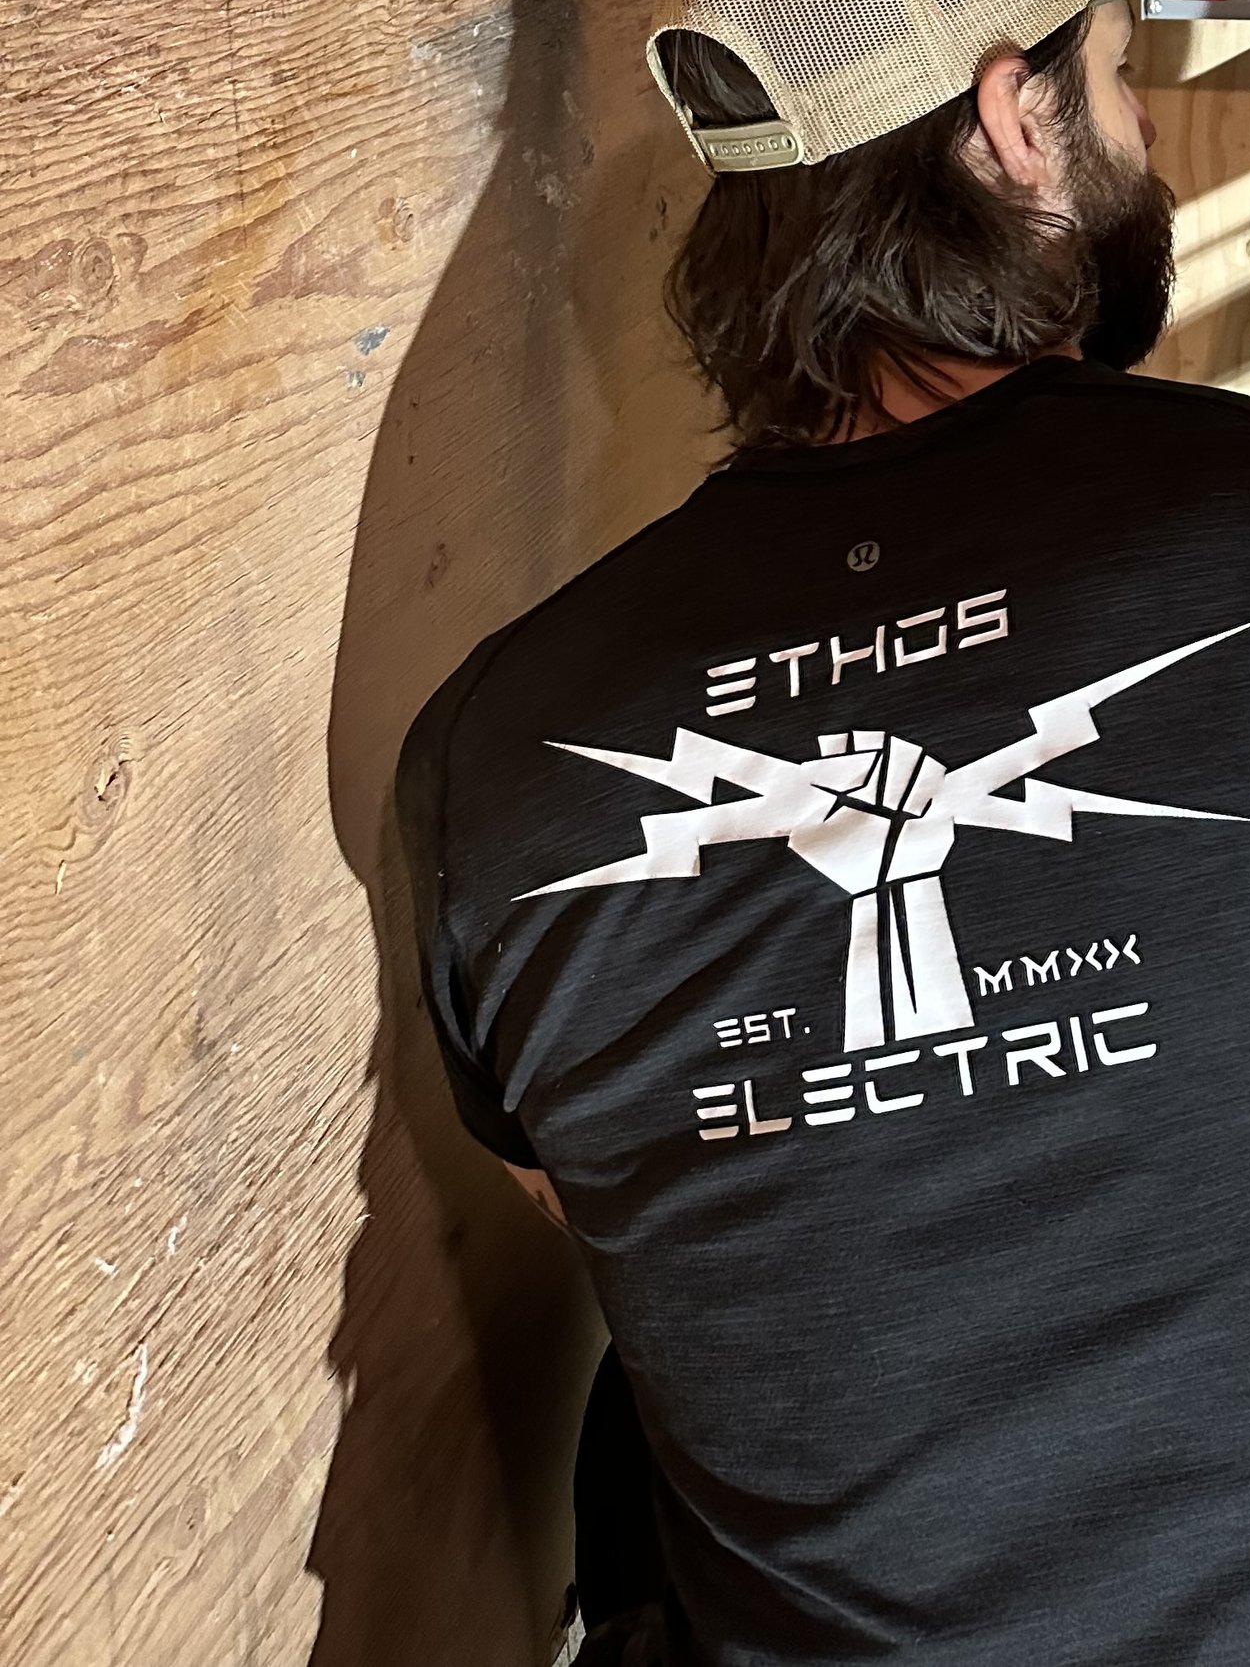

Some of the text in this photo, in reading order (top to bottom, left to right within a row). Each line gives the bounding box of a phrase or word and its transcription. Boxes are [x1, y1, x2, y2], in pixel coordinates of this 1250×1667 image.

[706, 589, 1009, 717] ETHOS
[713, 935, 1141, 1048] EST. MMXX
[692, 1002, 1158, 1141] ELECTRIC
